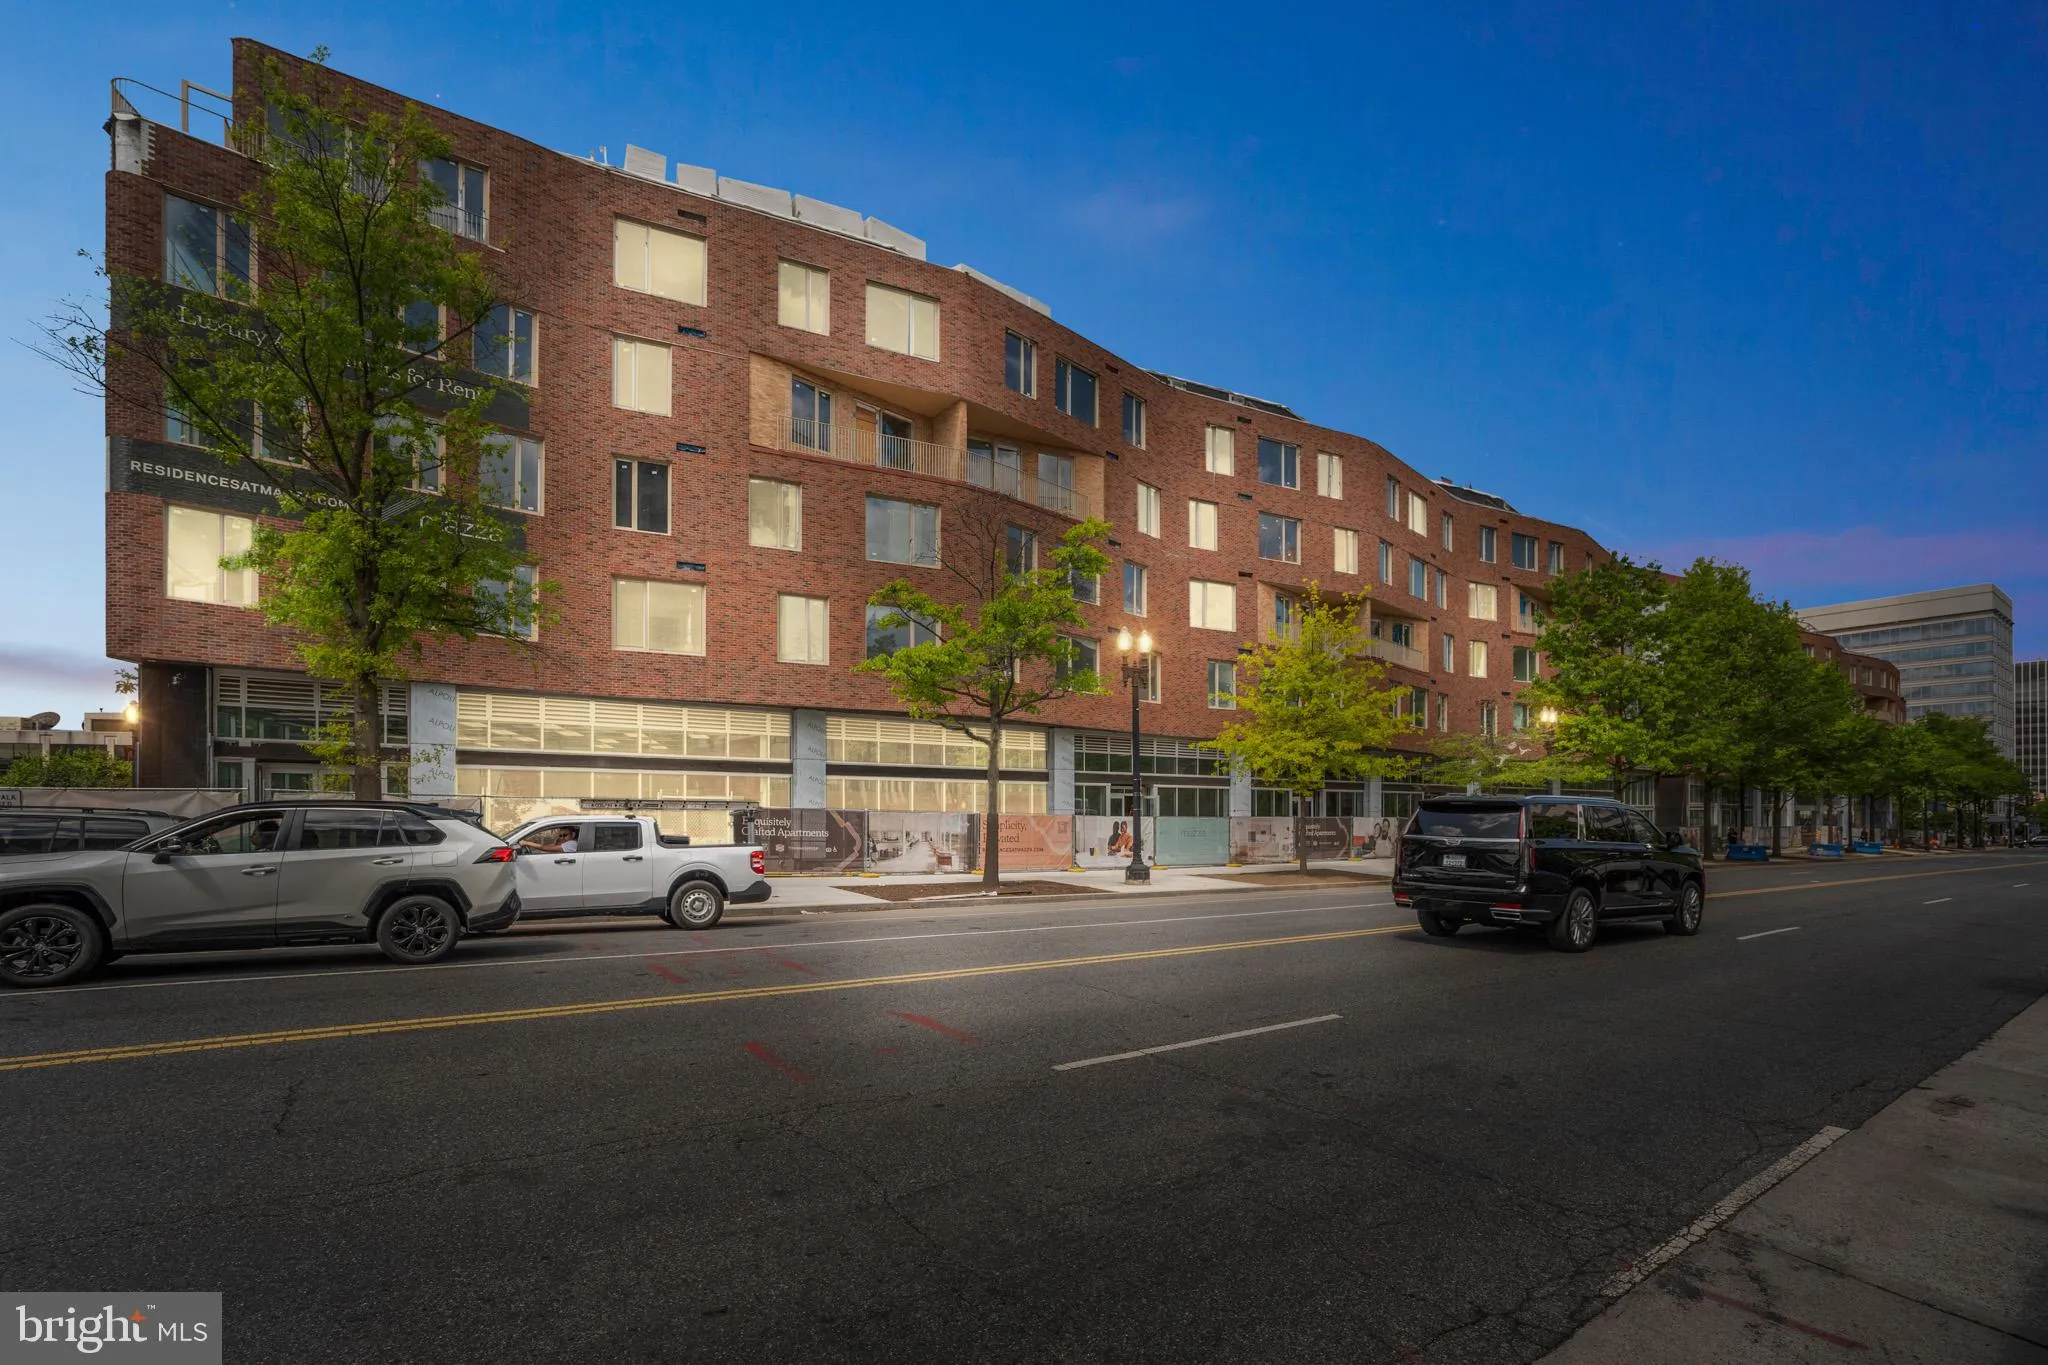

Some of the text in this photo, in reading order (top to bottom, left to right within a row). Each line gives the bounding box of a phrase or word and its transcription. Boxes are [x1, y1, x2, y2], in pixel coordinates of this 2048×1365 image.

[438, 377, 482, 401] Ren
[742, 816, 792, 828] Equisitely
[983, 820, 1027, 832] Splicity,
[742, 827, 829, 838] Cafted Apartments
